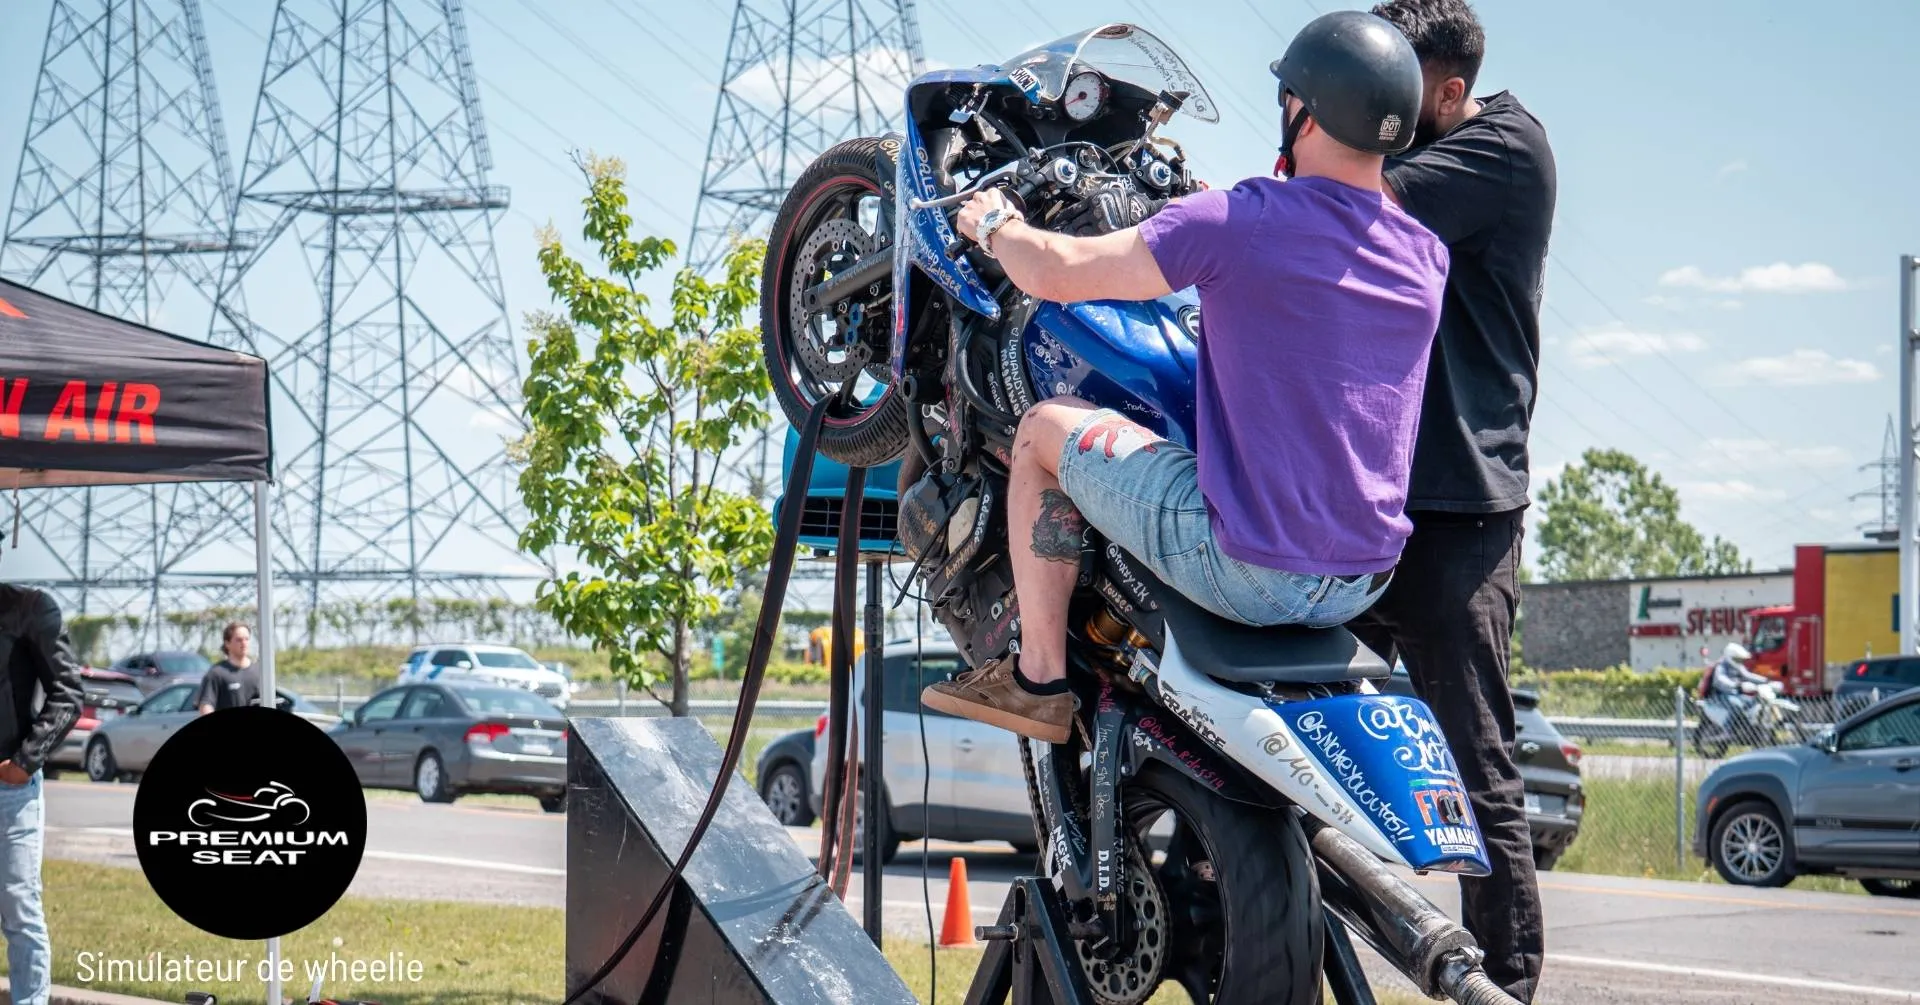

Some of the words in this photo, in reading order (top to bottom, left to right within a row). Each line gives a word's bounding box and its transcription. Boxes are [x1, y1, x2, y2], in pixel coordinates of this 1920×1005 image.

[1382, 121, 1399, 131] DOT
[44, 379, 162, 445] AIR
[1414, 790, 1473, 826] FIT
[1053, 825, 1073, 872] NGK
[1424, 827, 1480, 848] YAMAHA
[1098, 850, 1111, 891] D.I.D.
